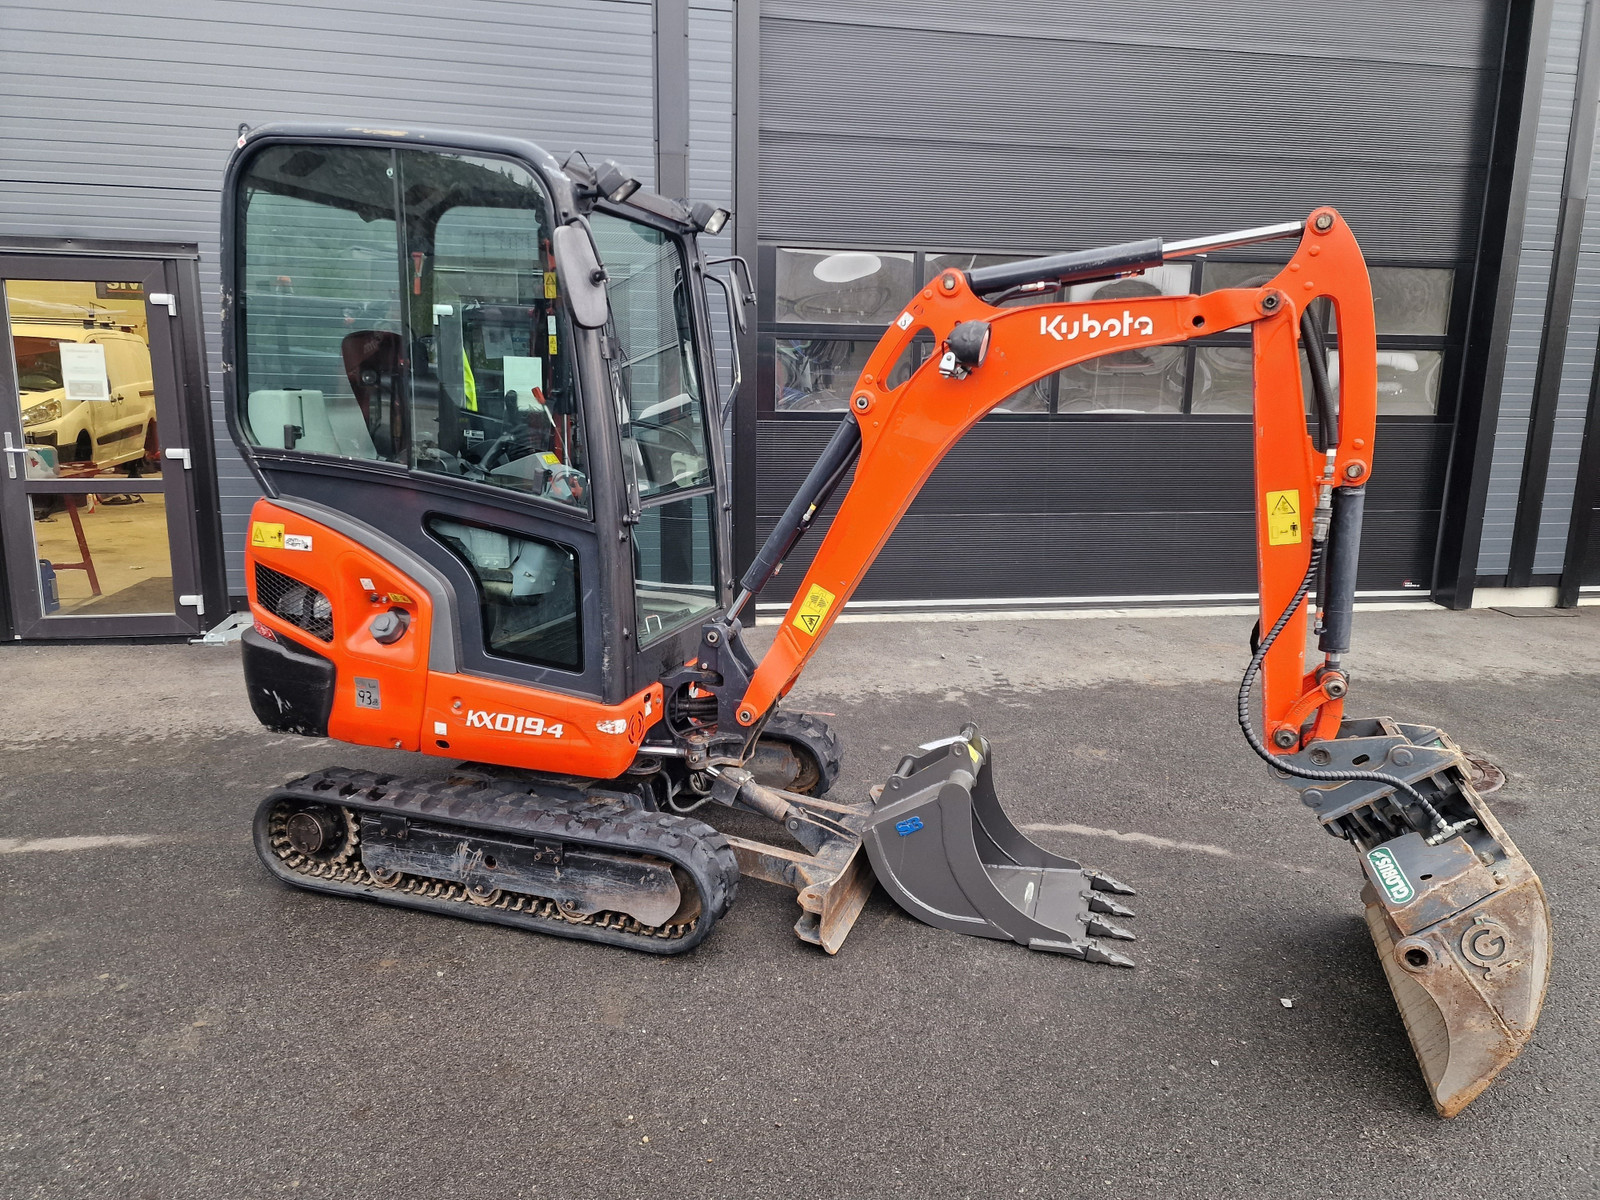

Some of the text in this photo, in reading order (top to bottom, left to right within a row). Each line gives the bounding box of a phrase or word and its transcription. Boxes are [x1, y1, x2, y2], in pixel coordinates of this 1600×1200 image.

[1040, 310, 1153, 341] Kubota
[358, 690, 372, 705] 93
[1374, 857, 1409, 899] GLOBUS
